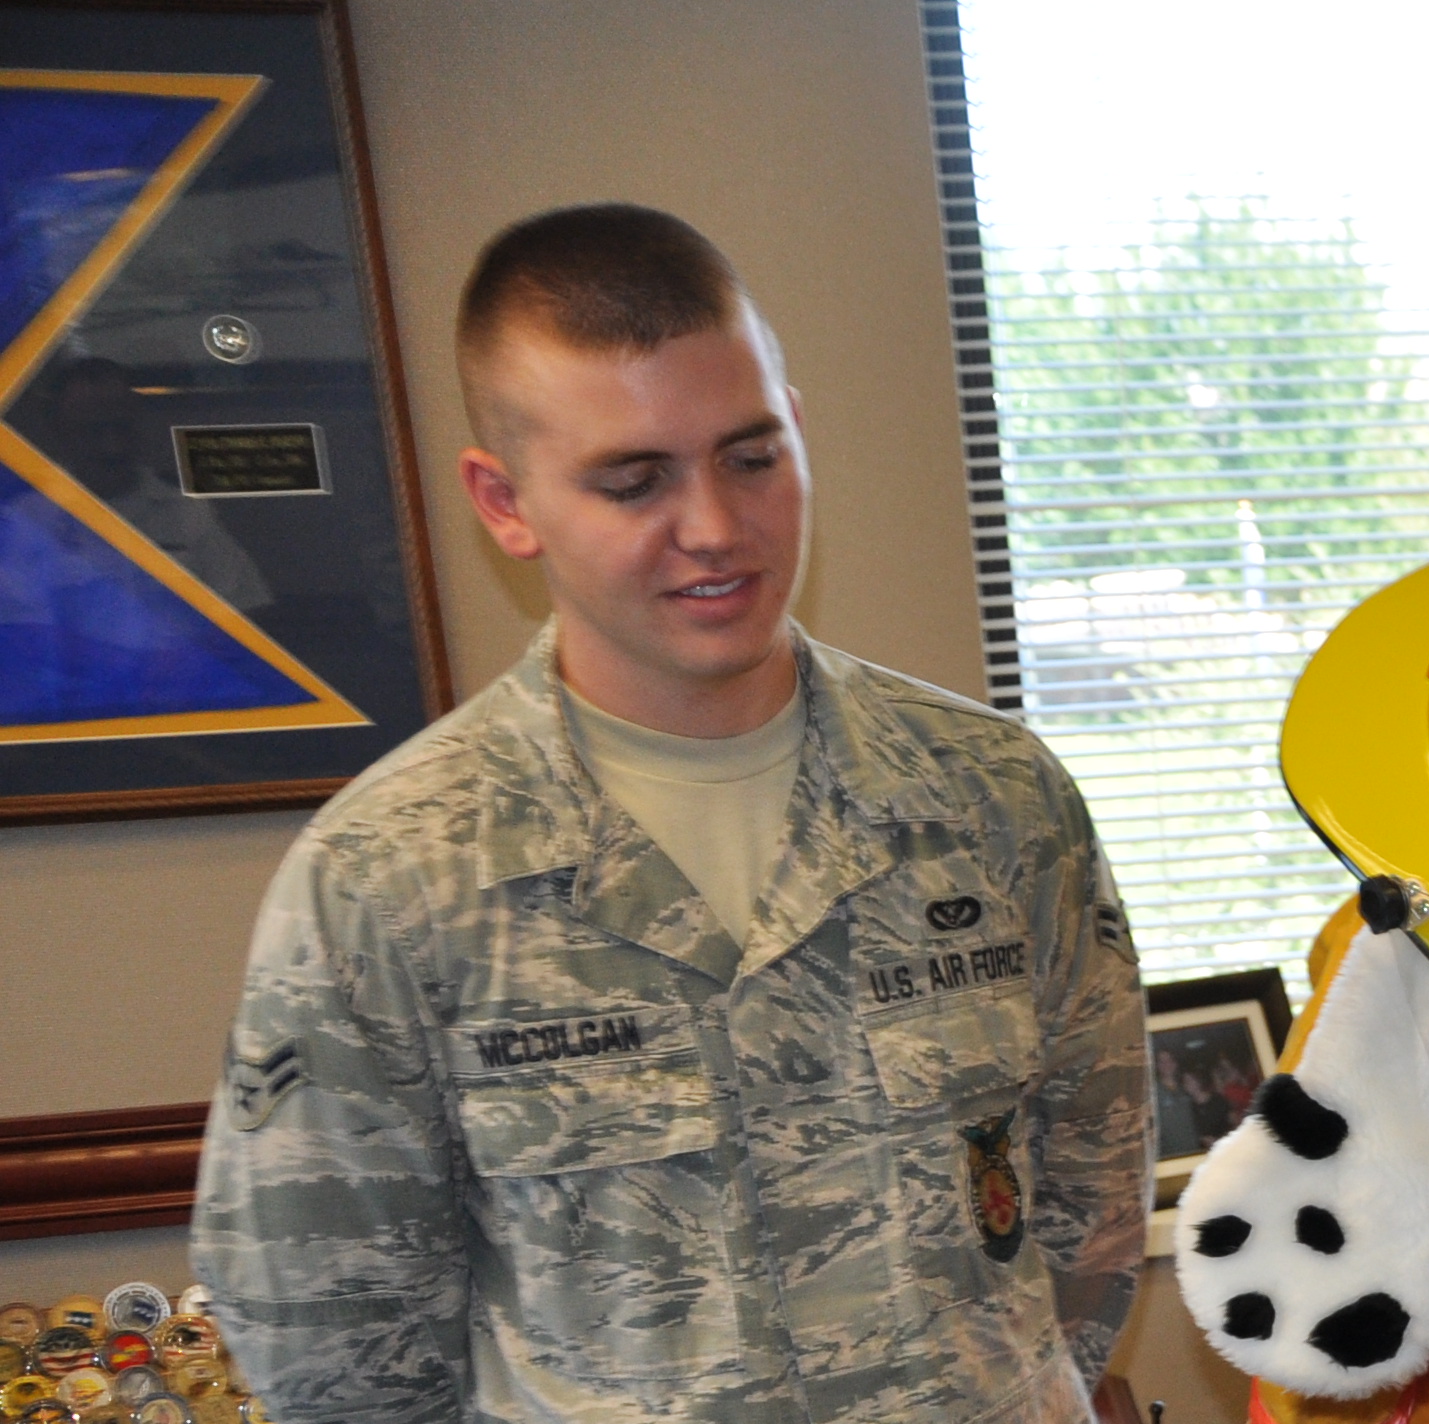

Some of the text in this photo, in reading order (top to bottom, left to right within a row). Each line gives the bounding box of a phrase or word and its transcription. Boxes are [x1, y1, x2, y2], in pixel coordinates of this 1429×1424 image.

[868, 942, 1024, 1003] U.S. AIR FORCE
[474, 1016, 641, 1068] MCCOLGAN
